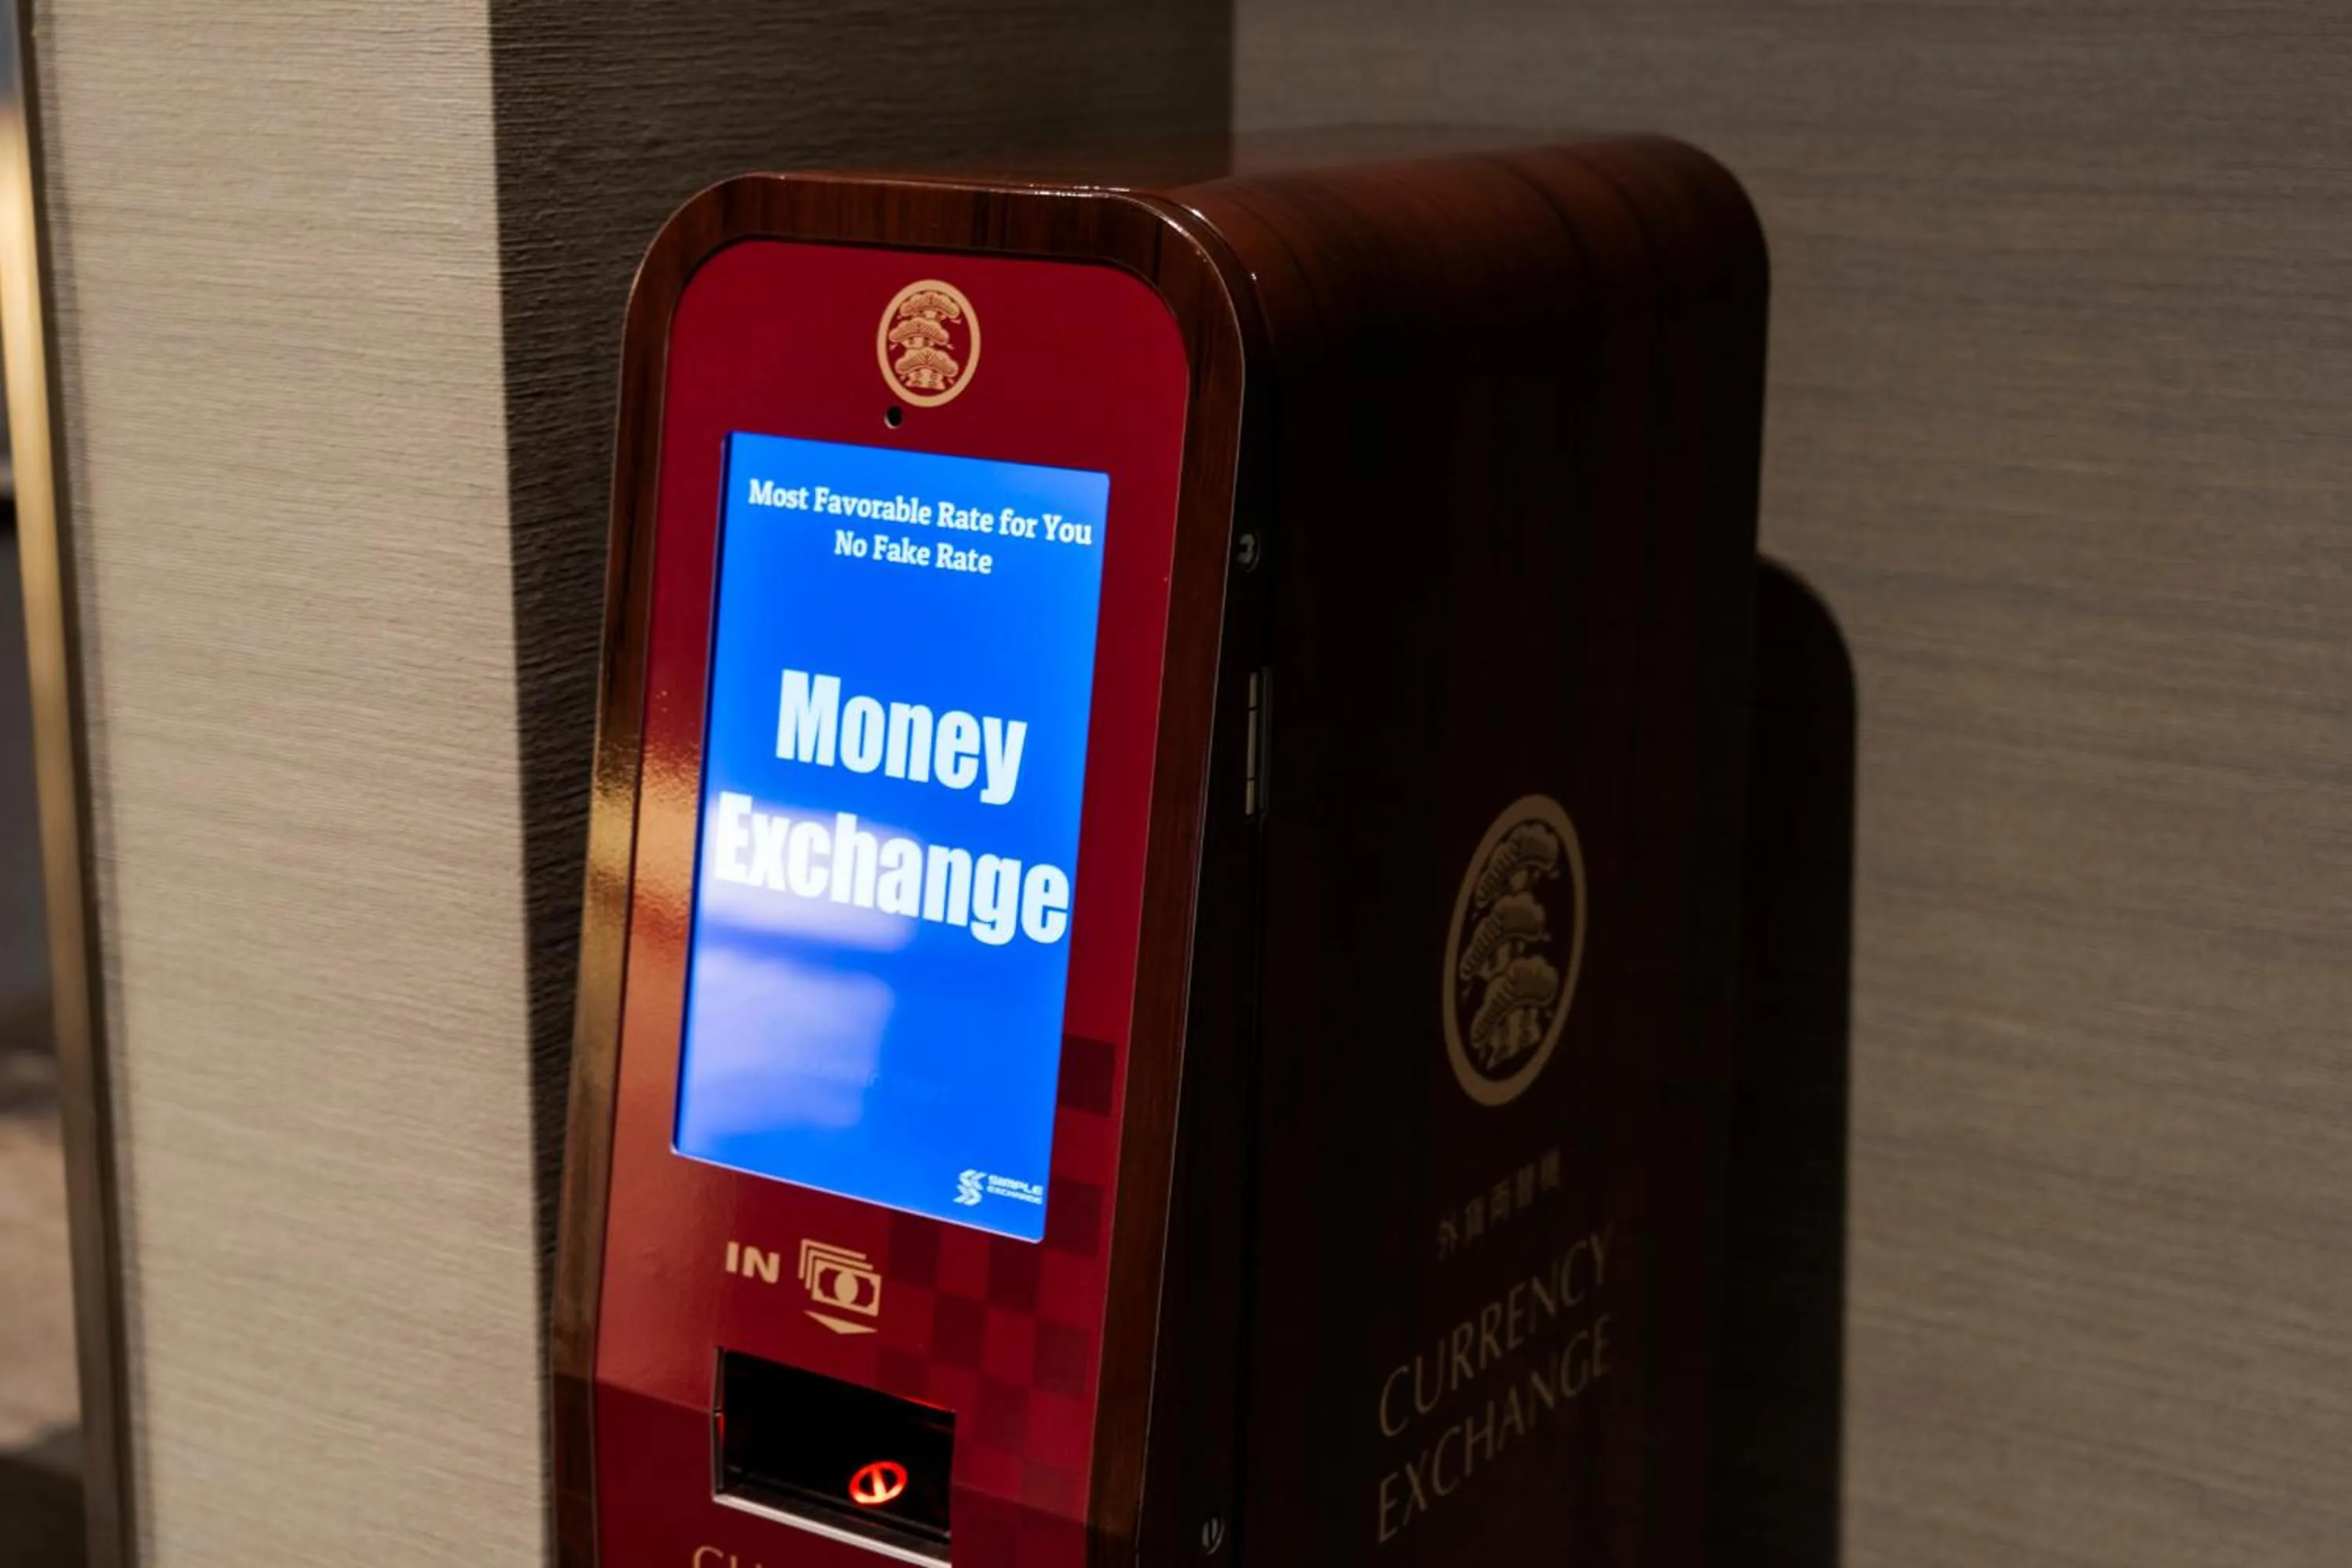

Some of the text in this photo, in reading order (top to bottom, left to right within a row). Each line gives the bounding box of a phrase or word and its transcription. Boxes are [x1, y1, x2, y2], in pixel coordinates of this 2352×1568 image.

[749, 479, 1093, 545] Most Favorable Rate for You
[834, 530, 993, 574] No Fake Rate
[775, 669, 1028, 806] Money
[714, 792, 1070, 946] Exchange
[725, 1241, 780, 1284] IN
[1377, 1221, 1613, 1439] CURRENCY
[1377, 1313, 1611, 1544] EXCHANGE
